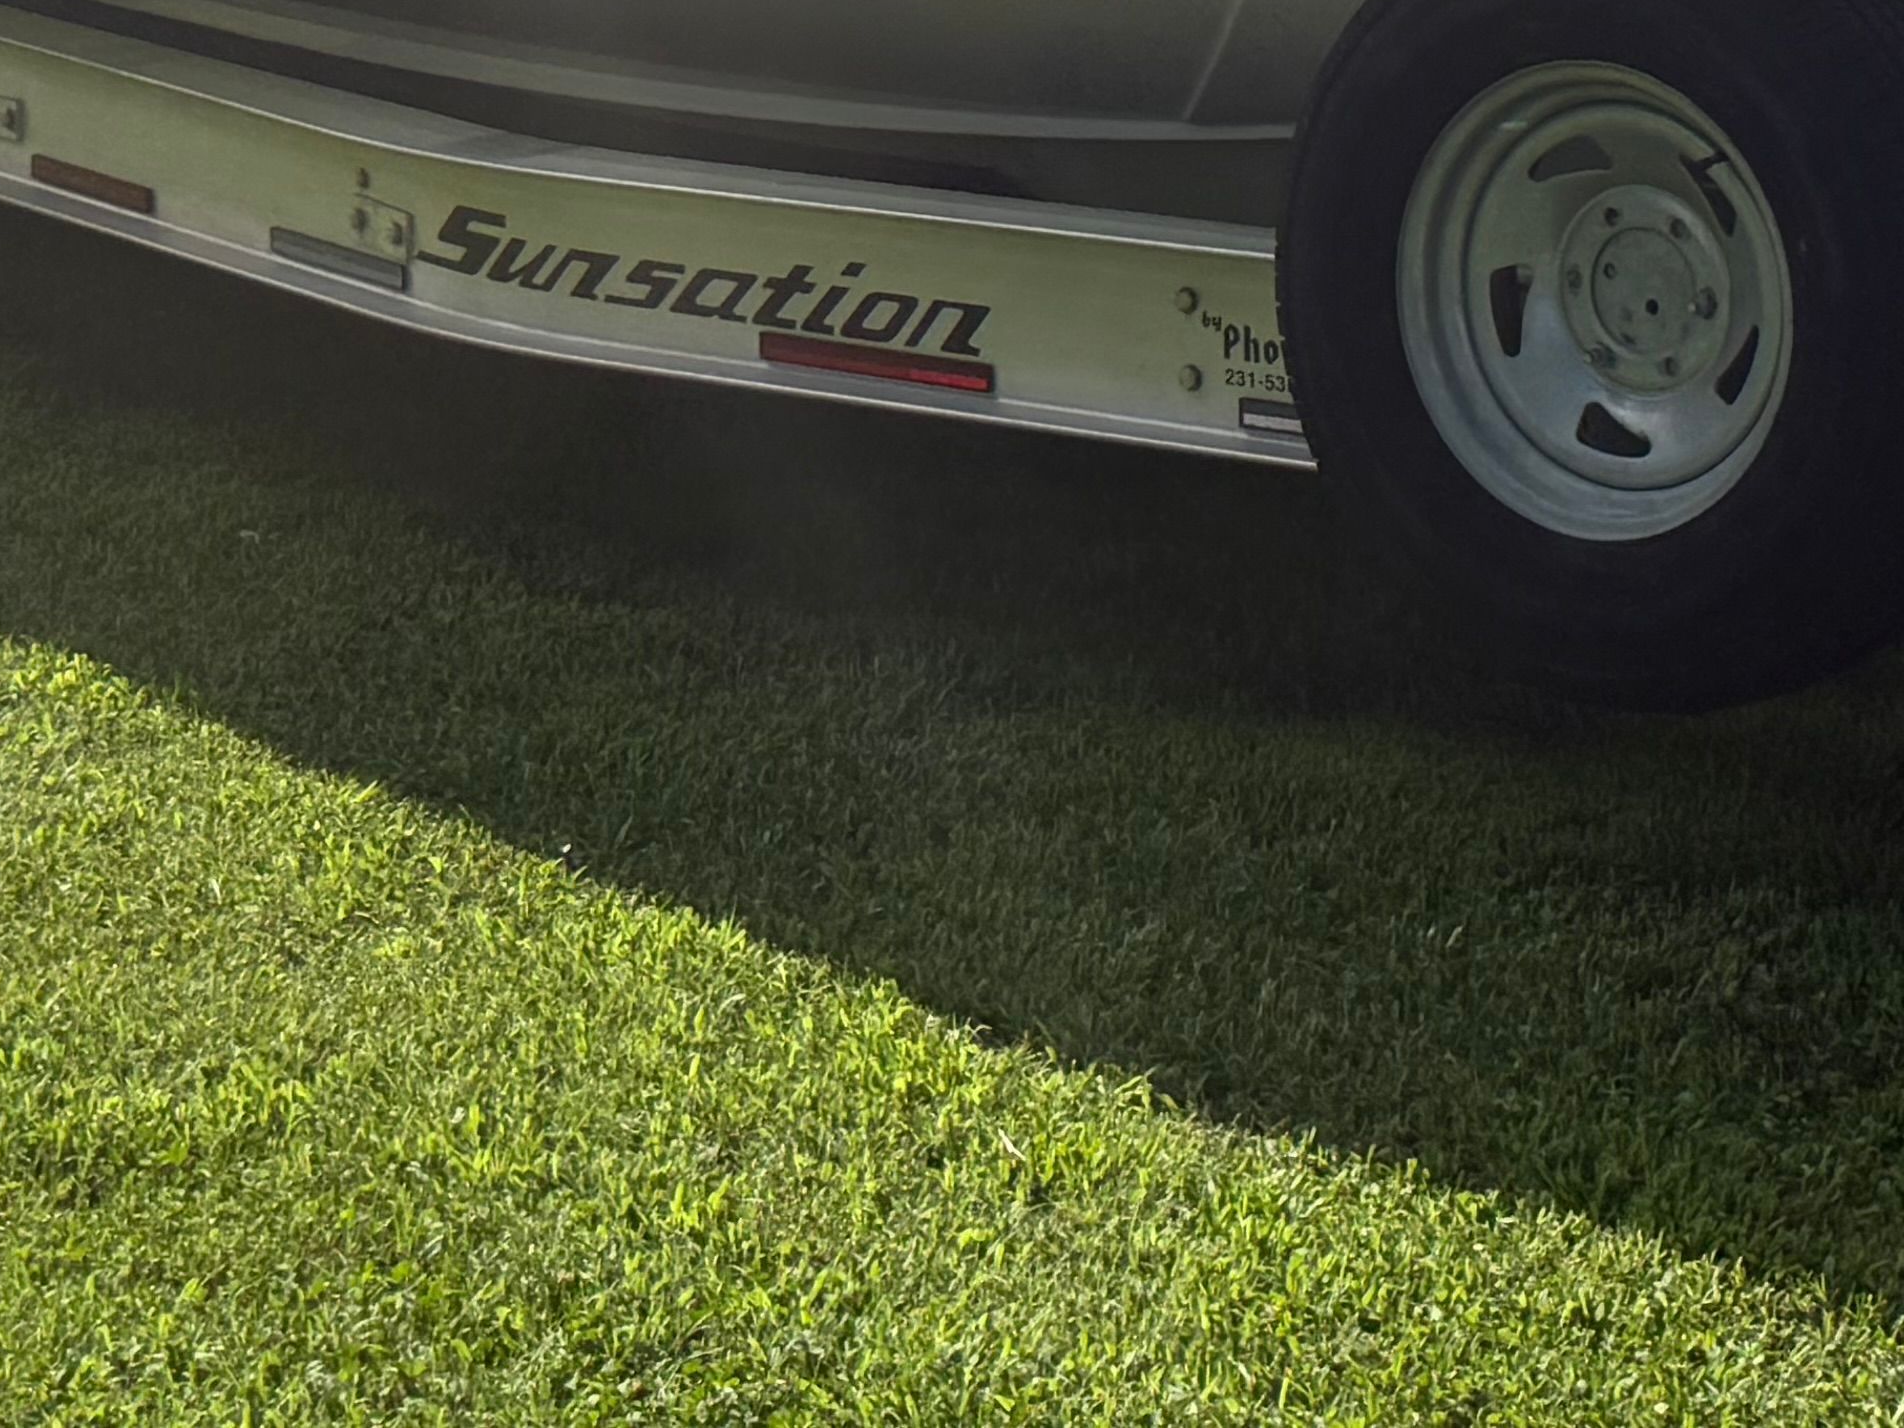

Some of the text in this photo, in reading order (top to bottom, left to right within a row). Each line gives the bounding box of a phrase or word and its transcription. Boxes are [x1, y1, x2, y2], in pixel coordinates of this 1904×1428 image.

[416, 204, 991, 357] Sunsation
[1202, 310, 1222, 332] by
[1223, 323, 1282, 365] Pho
[1225, 368, 1292, 393] 231-53
